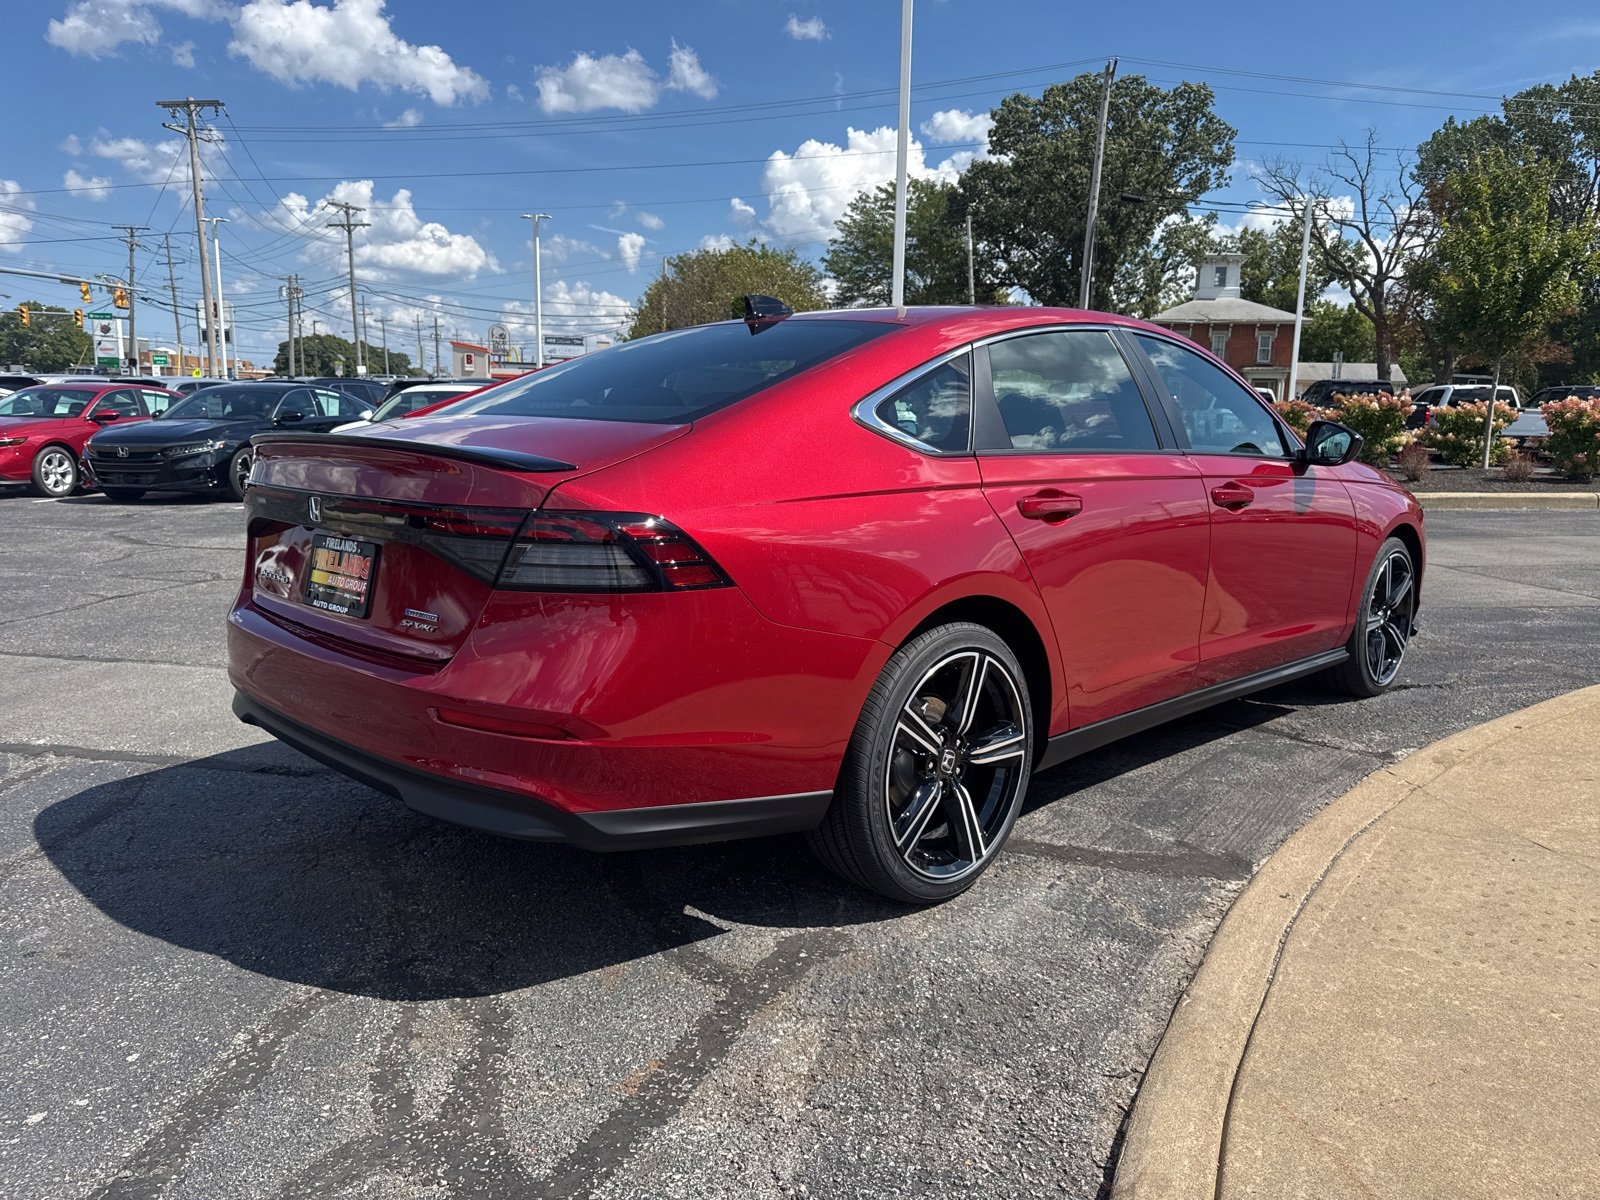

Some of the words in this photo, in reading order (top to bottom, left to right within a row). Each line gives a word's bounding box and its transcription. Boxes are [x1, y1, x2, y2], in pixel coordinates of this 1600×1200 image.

[466, 354, 473, 365] B
[325, 537, 358, 553] FIRELANDS
[327, 575, 345, 587] AUTO
[312, 599, 328, 609] AUTO
[328, 603, 349, 614] GROUP
